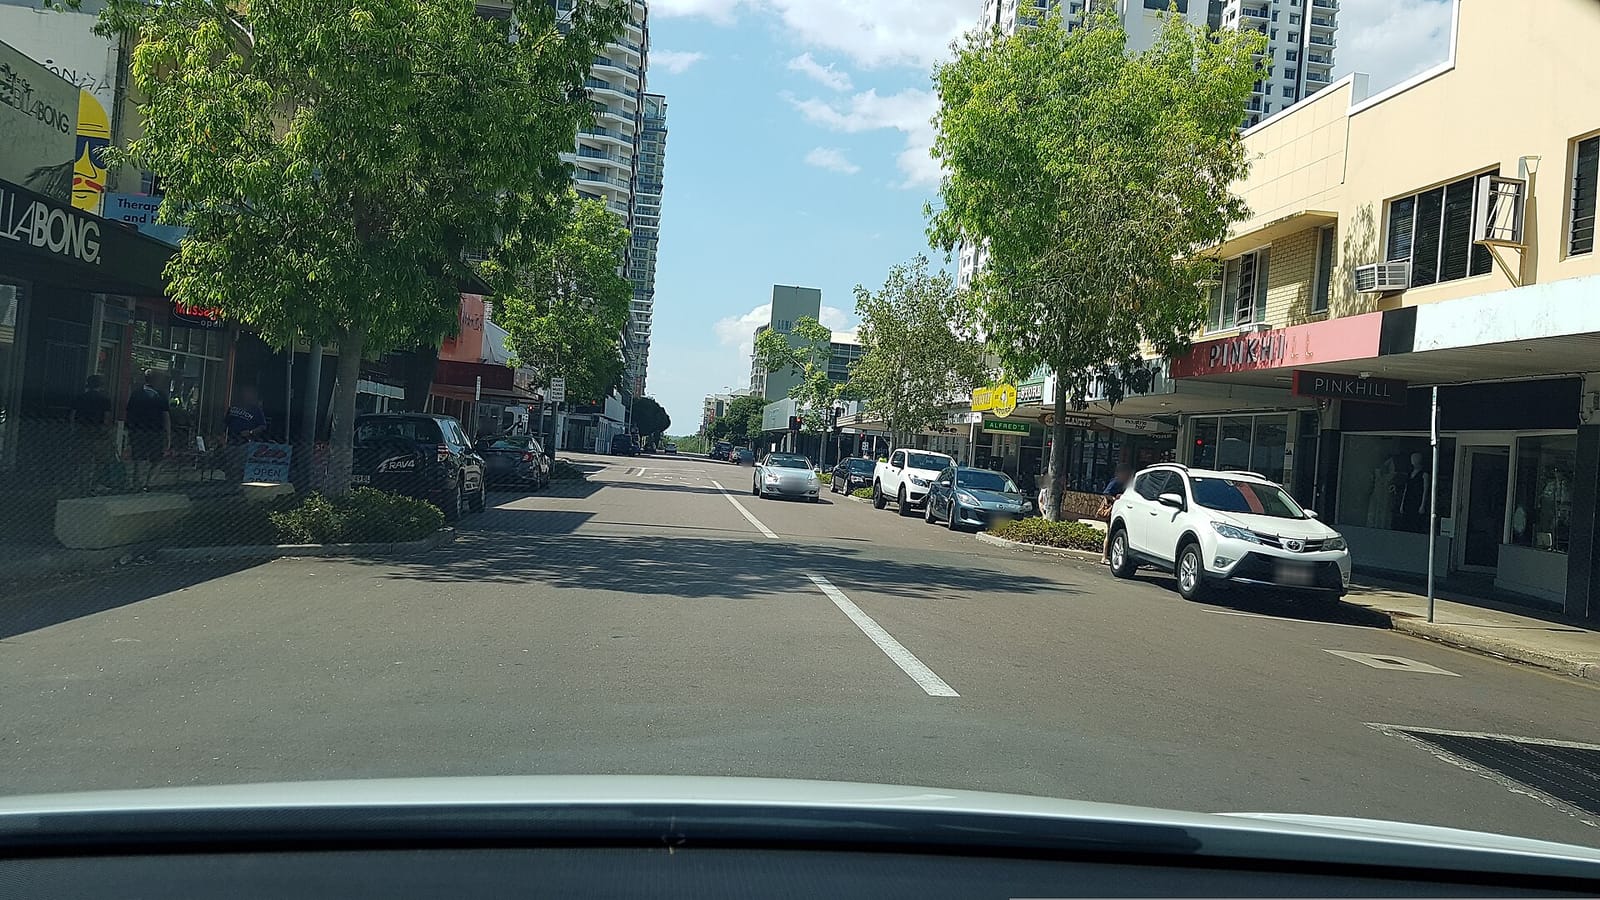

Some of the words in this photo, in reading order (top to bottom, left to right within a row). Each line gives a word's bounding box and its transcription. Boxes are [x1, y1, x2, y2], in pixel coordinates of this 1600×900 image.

[117, 198, 161, 213] Therap
[123, 213, 147, 223] and
[1314, 377, 1391, 397] PINKHILL
[989, 422, 1025, 430] ALFRED'S
[389, 459, 415, 469] RAV4
[254, 467, 281, 477] OPEN
